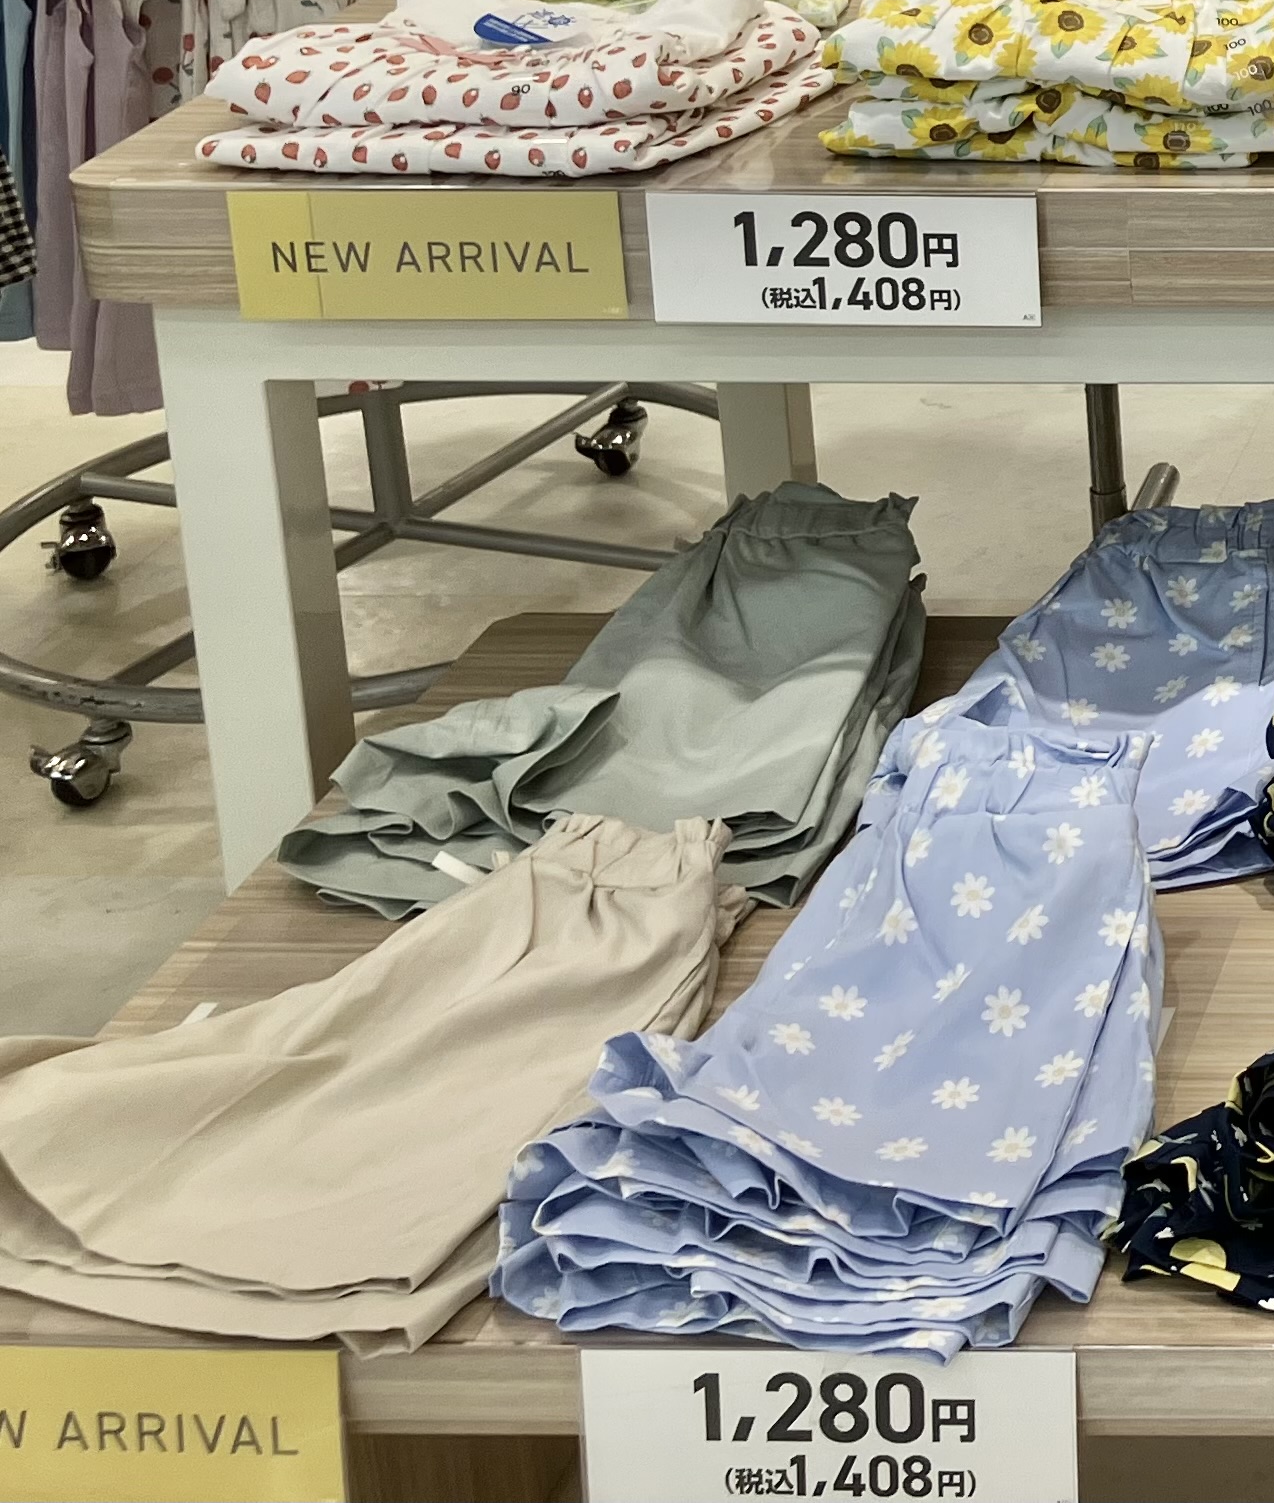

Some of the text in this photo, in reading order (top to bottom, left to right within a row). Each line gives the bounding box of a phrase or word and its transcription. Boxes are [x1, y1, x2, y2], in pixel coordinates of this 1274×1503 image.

[1217, 17, 1239, 27] 100
[1224, 38, 1247, 51] 100
[1234, 64, 1258, 81] 100
[511, 83, 531, 96] 90
[1248, 99, 1273, 116] 100
[733, 211, 958, 269] 1,280円
[272, 241, 590, 273] NEW ARRIVAL
[691, 1372, 976, 1444] 1,280円
[0, 1410, 299, 1455] W ARRIVAL
